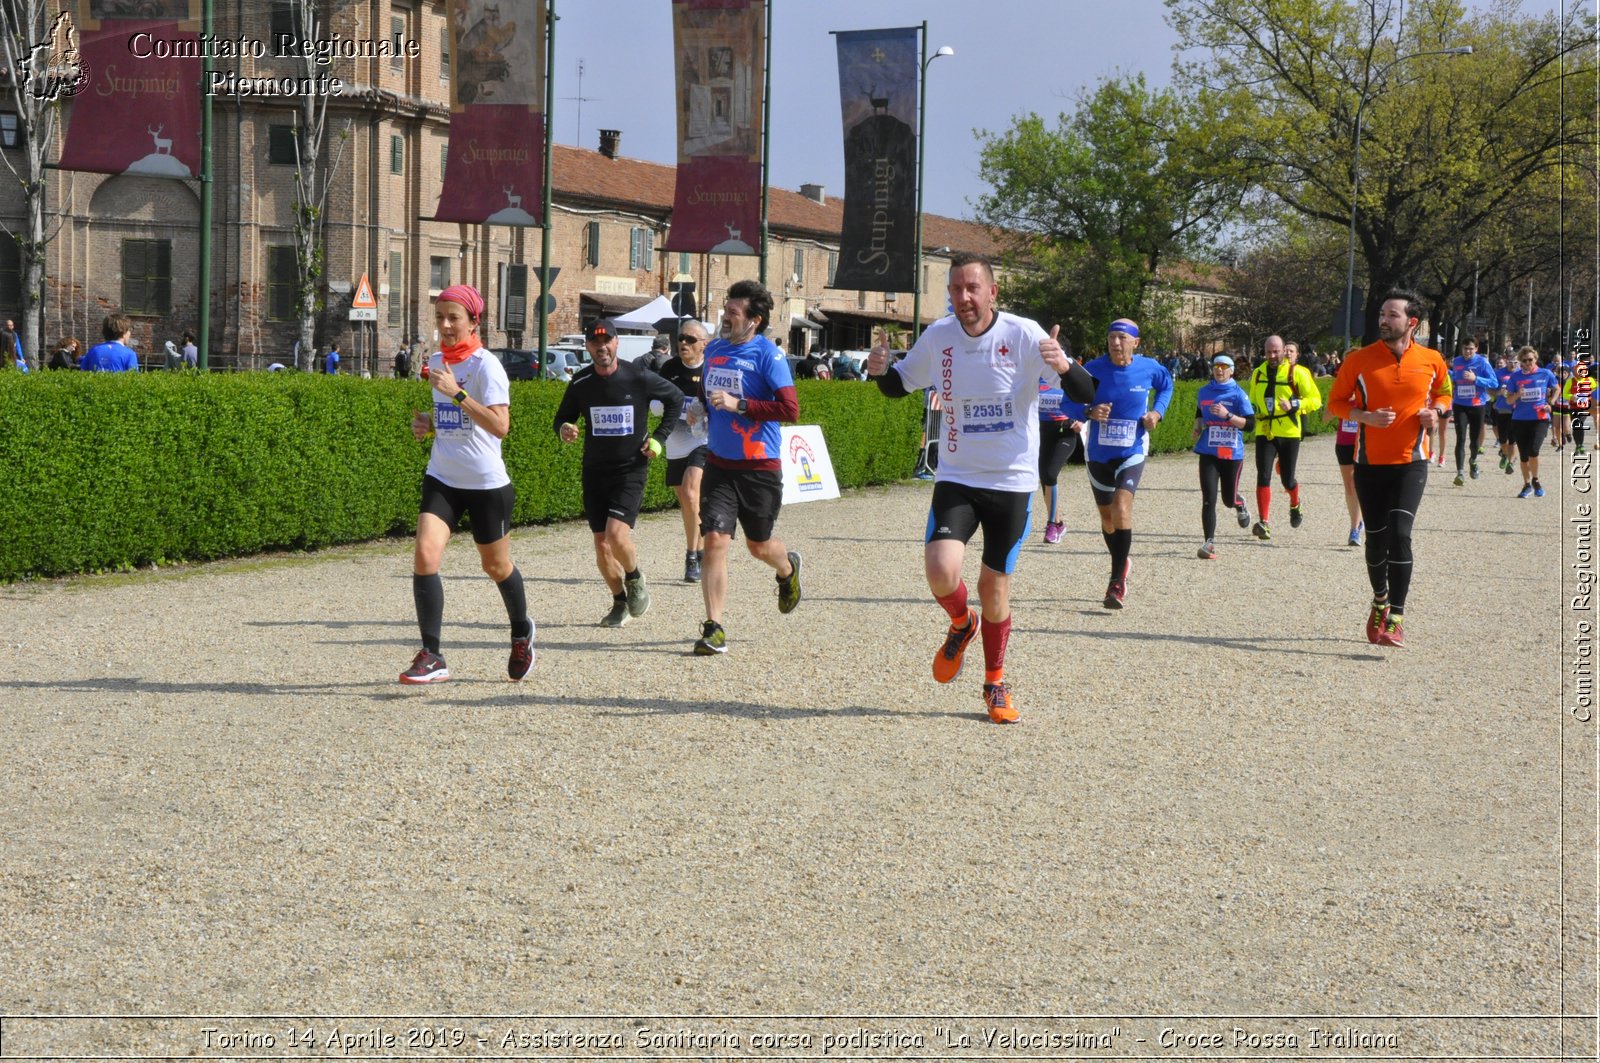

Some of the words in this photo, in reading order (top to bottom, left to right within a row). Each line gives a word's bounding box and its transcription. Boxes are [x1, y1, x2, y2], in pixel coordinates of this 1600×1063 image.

[96, 64, 181, 99] Stupinigi
[463, 139, 529, 165] Stupinigi
[687, 185, 749, 206] Stupinigi
[857, 156, 897, 275] Stupinigi
[356, 310, 364, 318] 30
[712, 375, 732, 388] 2429
[941, 345, 954, 402] ROSSA
[438, 410, 460, 424] 1449
[601, 413, 624, 424] 3490
[972, 404, 1004, 418] 2535
